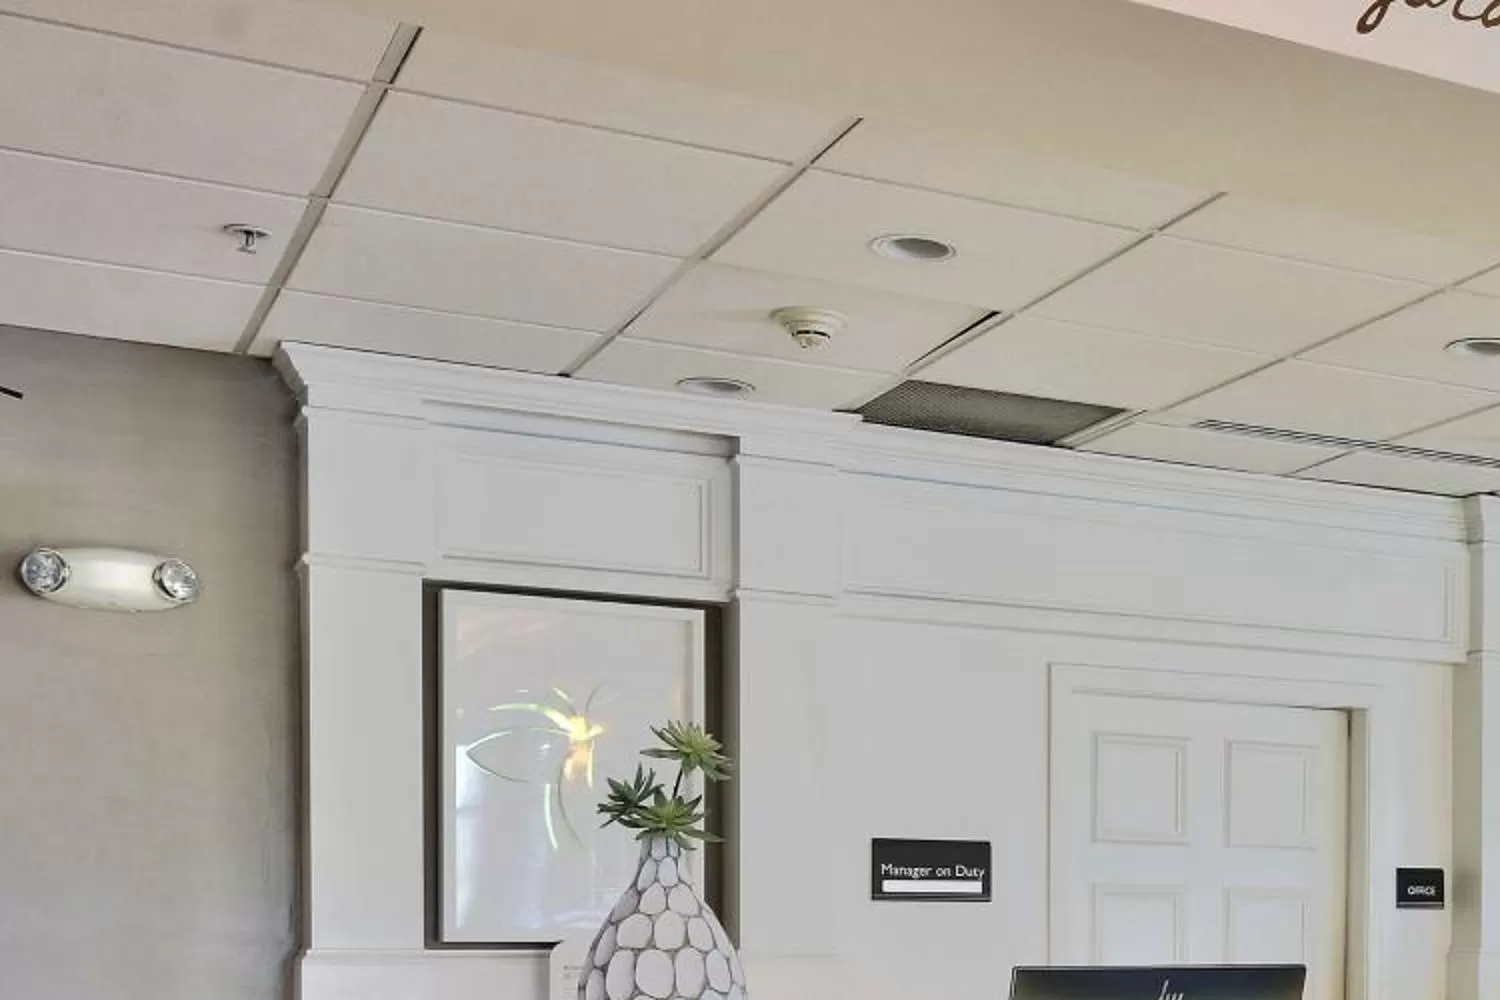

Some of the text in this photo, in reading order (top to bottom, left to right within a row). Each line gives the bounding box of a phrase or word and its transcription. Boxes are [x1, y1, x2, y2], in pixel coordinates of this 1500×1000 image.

[881, 863, 985, 880] Manager on Duty
